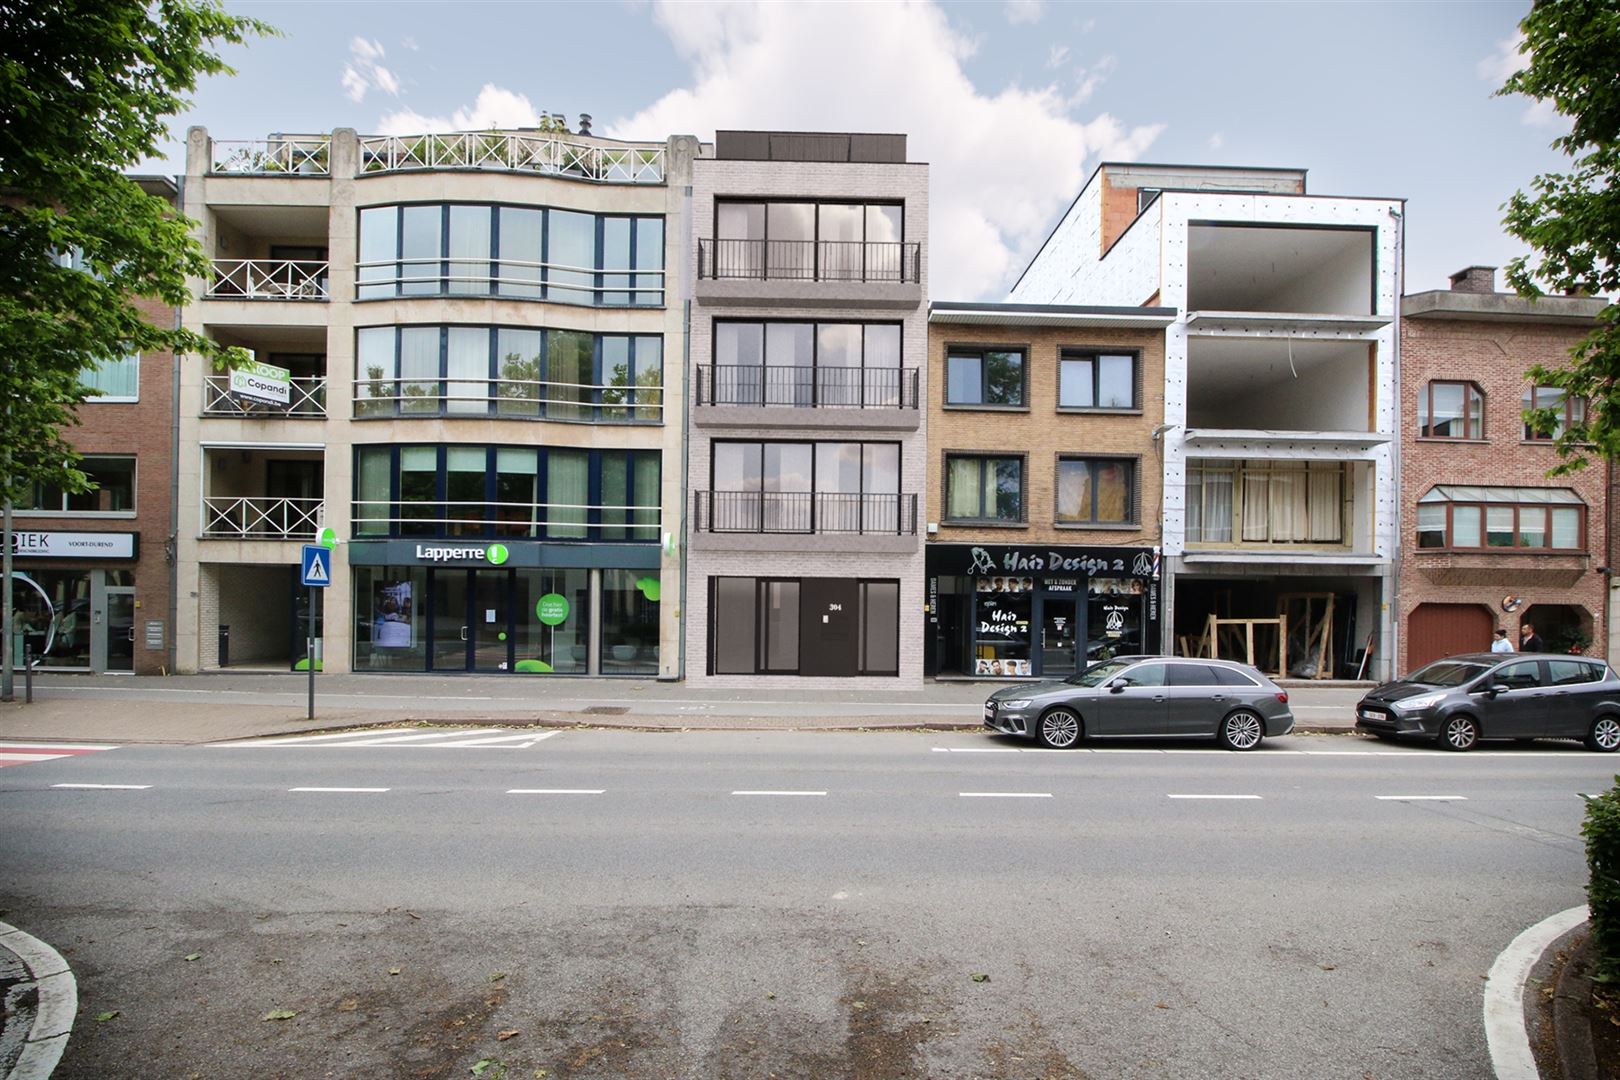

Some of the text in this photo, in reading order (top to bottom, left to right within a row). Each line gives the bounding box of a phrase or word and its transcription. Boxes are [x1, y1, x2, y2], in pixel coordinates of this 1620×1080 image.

[247, 378, 287, 395] Copandi
[416, 544, 485, 562] Lapperre
[1003, 551, 1125, 577] Hair Design 2
[991, 609, 1017, 622] Hair
[980, 621, 1018, 636] Design
[1020, 625, 1028, 633] 2
